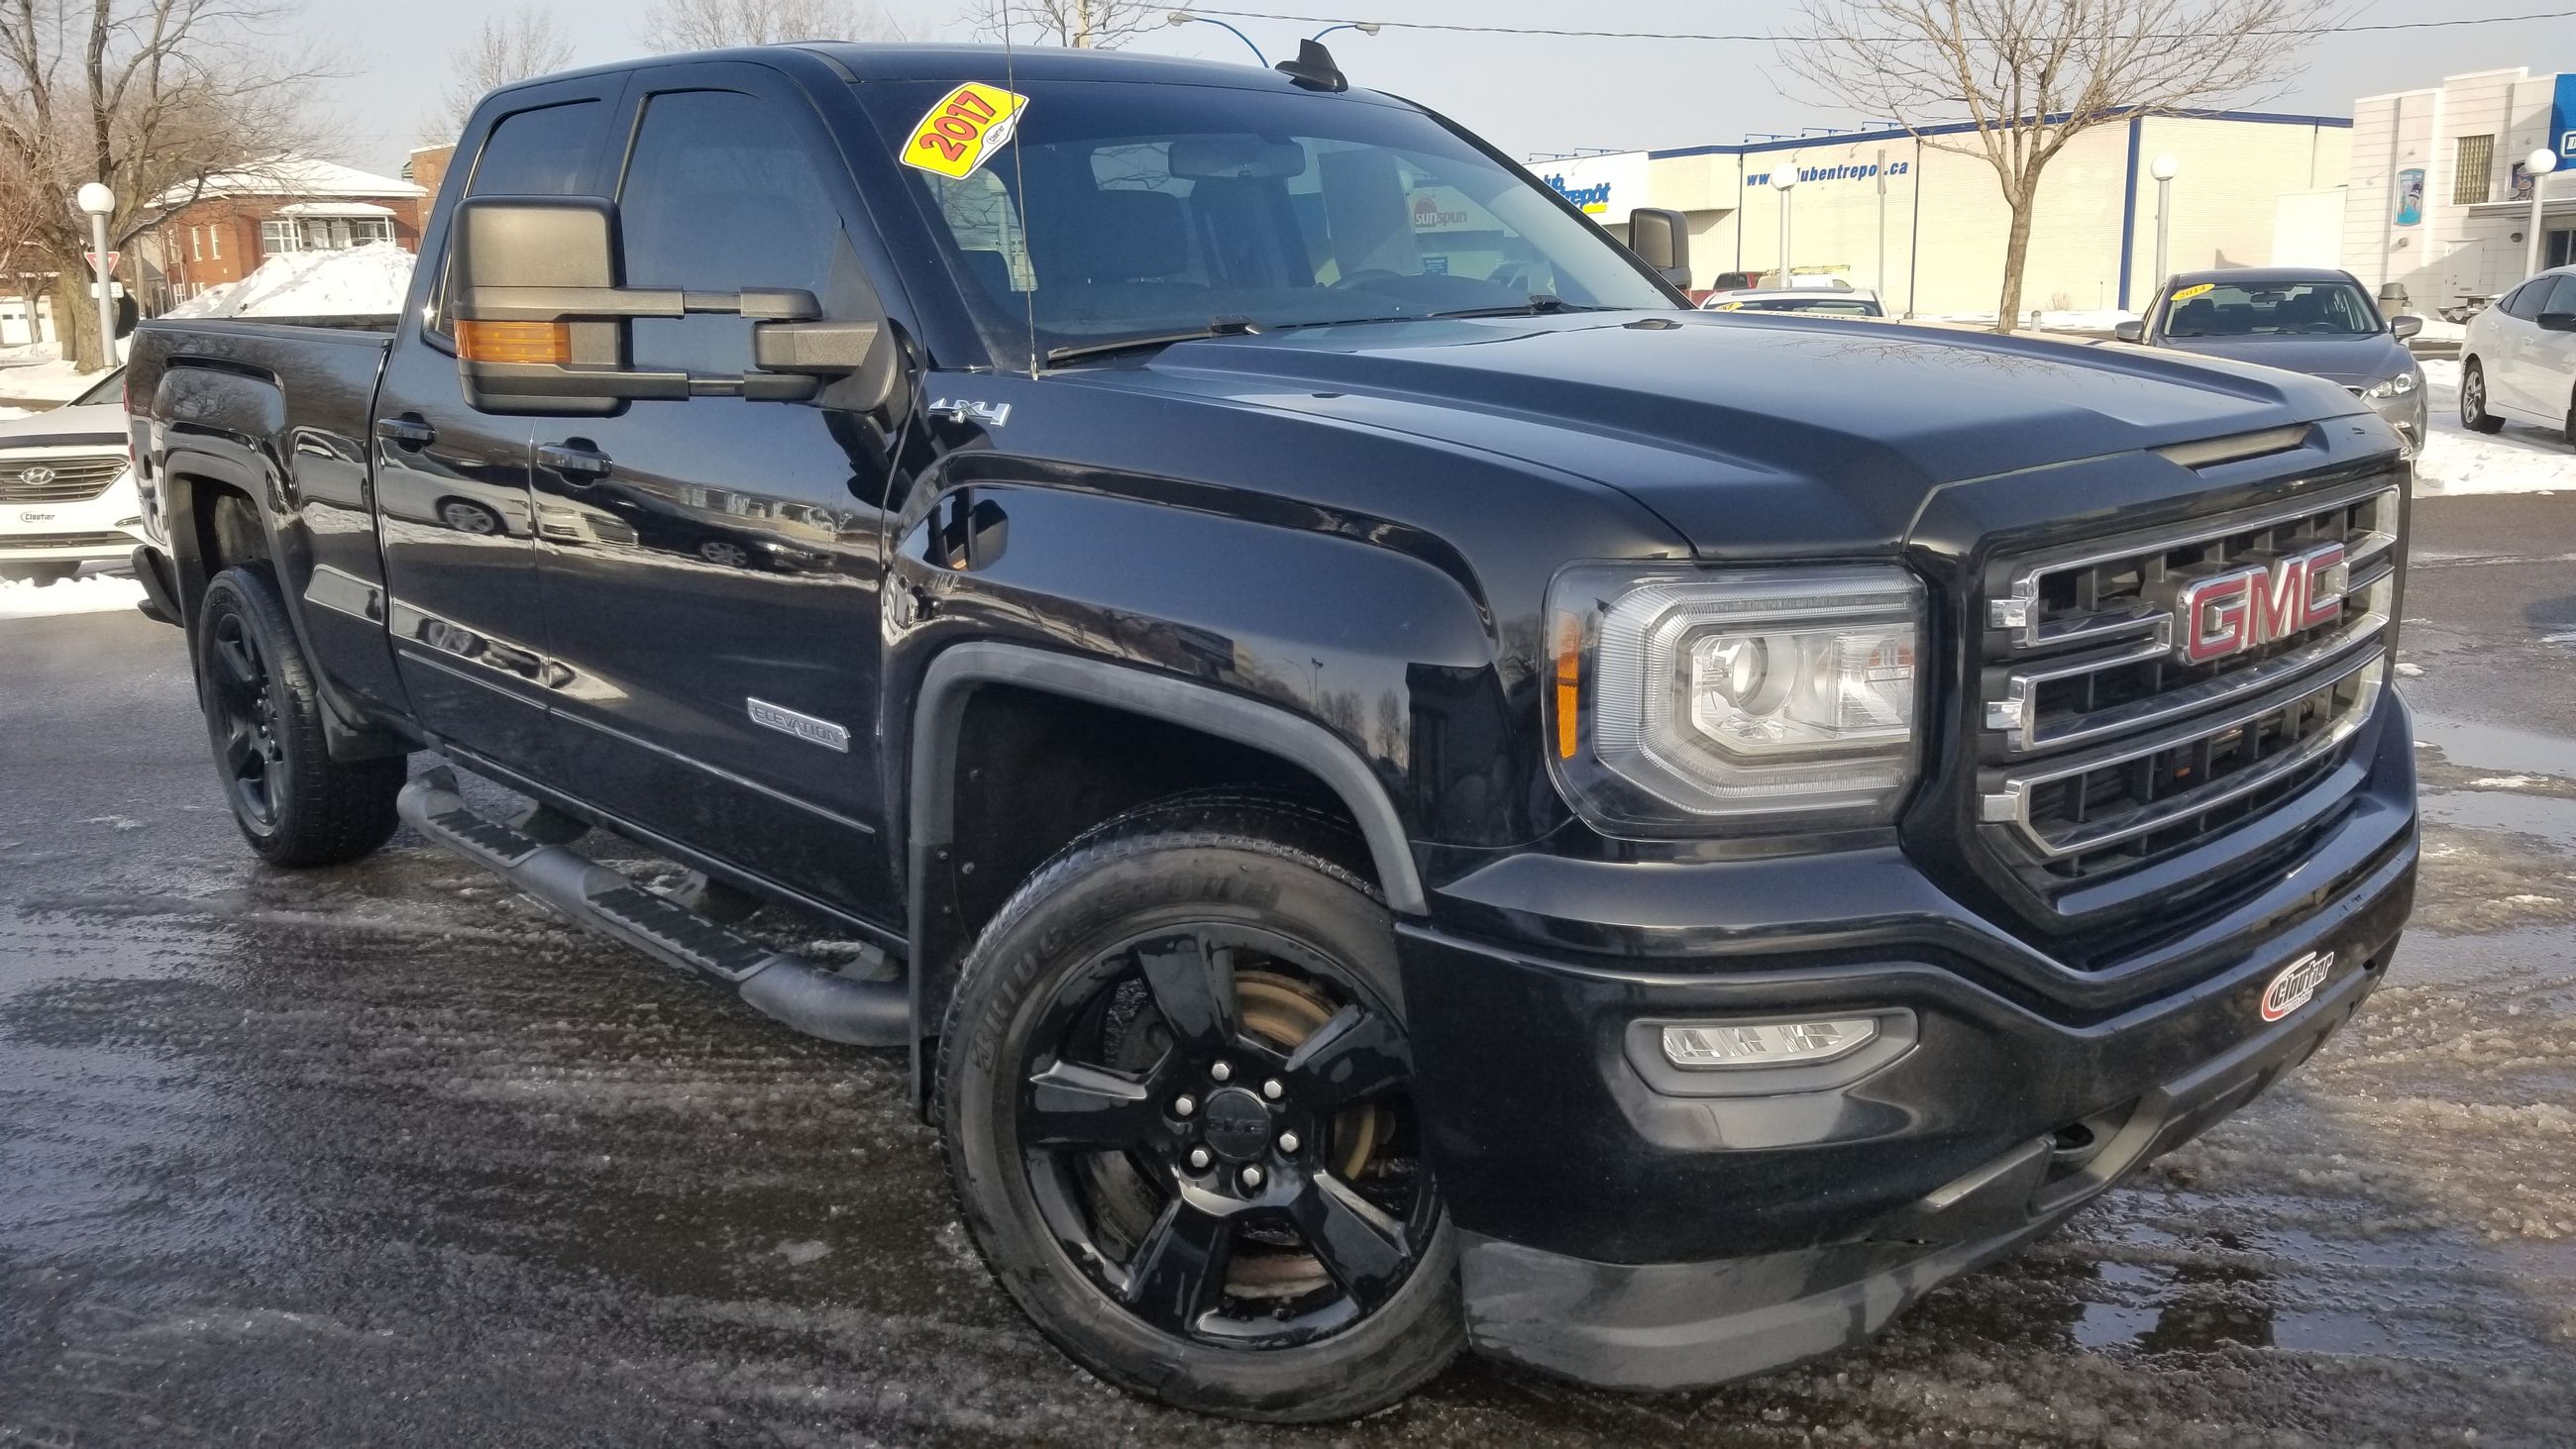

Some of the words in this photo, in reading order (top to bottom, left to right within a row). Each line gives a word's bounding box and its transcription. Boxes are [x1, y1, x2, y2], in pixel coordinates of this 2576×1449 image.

[919, 90, 997, 161] 2017
[1415, 212, 1468, 227] sunspun
[2188, 544, 2346, 662] GMC
[754, 708, 839, 743] ELEVATION
[2272, 953, 2334, 1008] Cloutier
